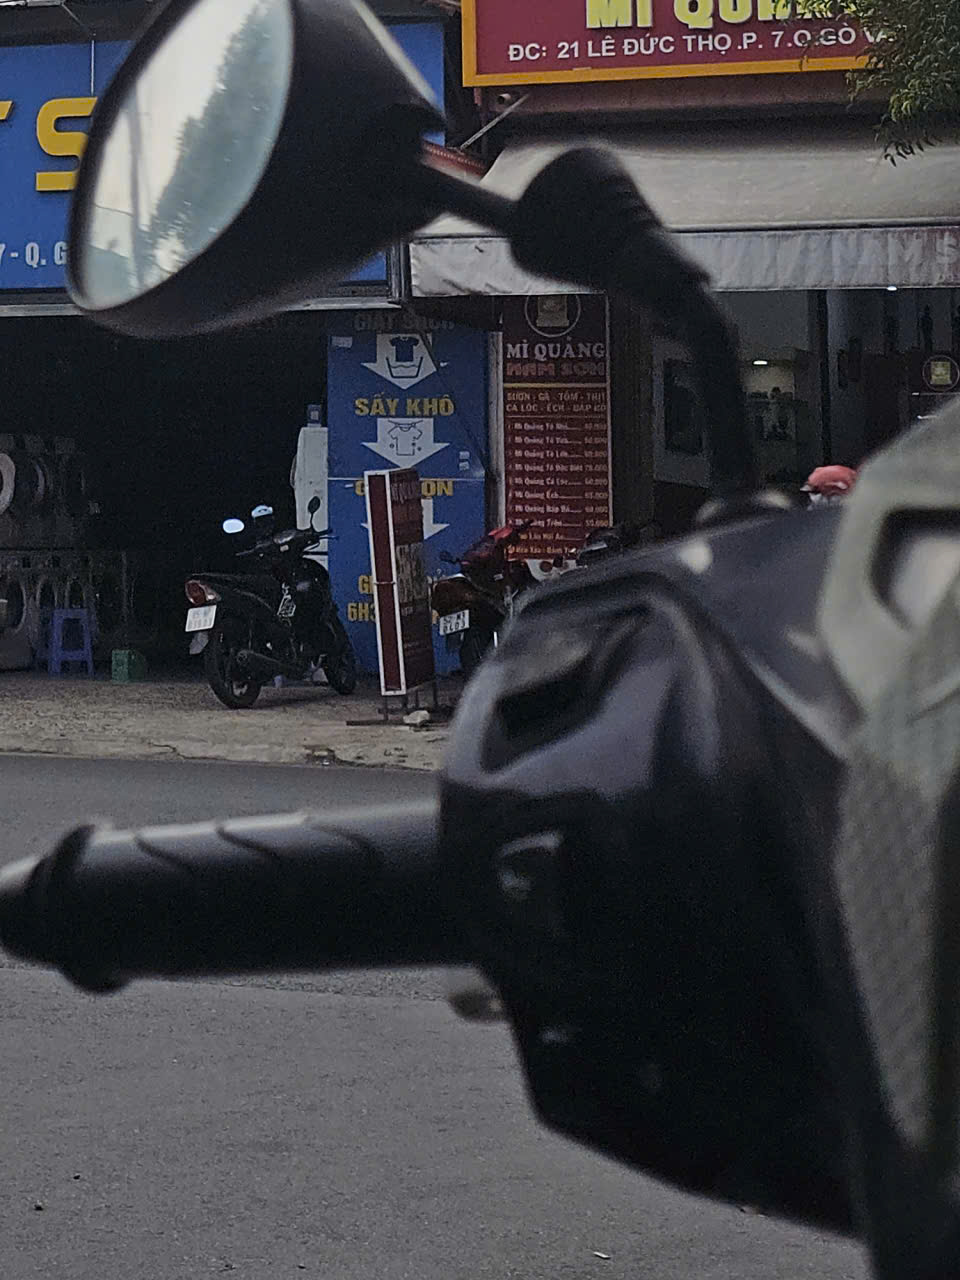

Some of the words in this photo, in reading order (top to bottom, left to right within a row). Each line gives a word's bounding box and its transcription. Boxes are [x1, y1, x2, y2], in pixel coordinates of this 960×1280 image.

[508, 43, 547, 61] ĐC:
[557, 41, 580, 59] 21
[587, 35, 617, 57] LÊ
[623, 33, 675, 56] ĐỨC
[682, 34, 732, 55] THỌ
[25, 242, 46, 266] Q.
[506, 338, 529, 360] MÌ
[534, 335, 606, 362] QUẢNG
[354, 391, 400, 417] SẤY
[406, 394, 455, 417] KHÔ
